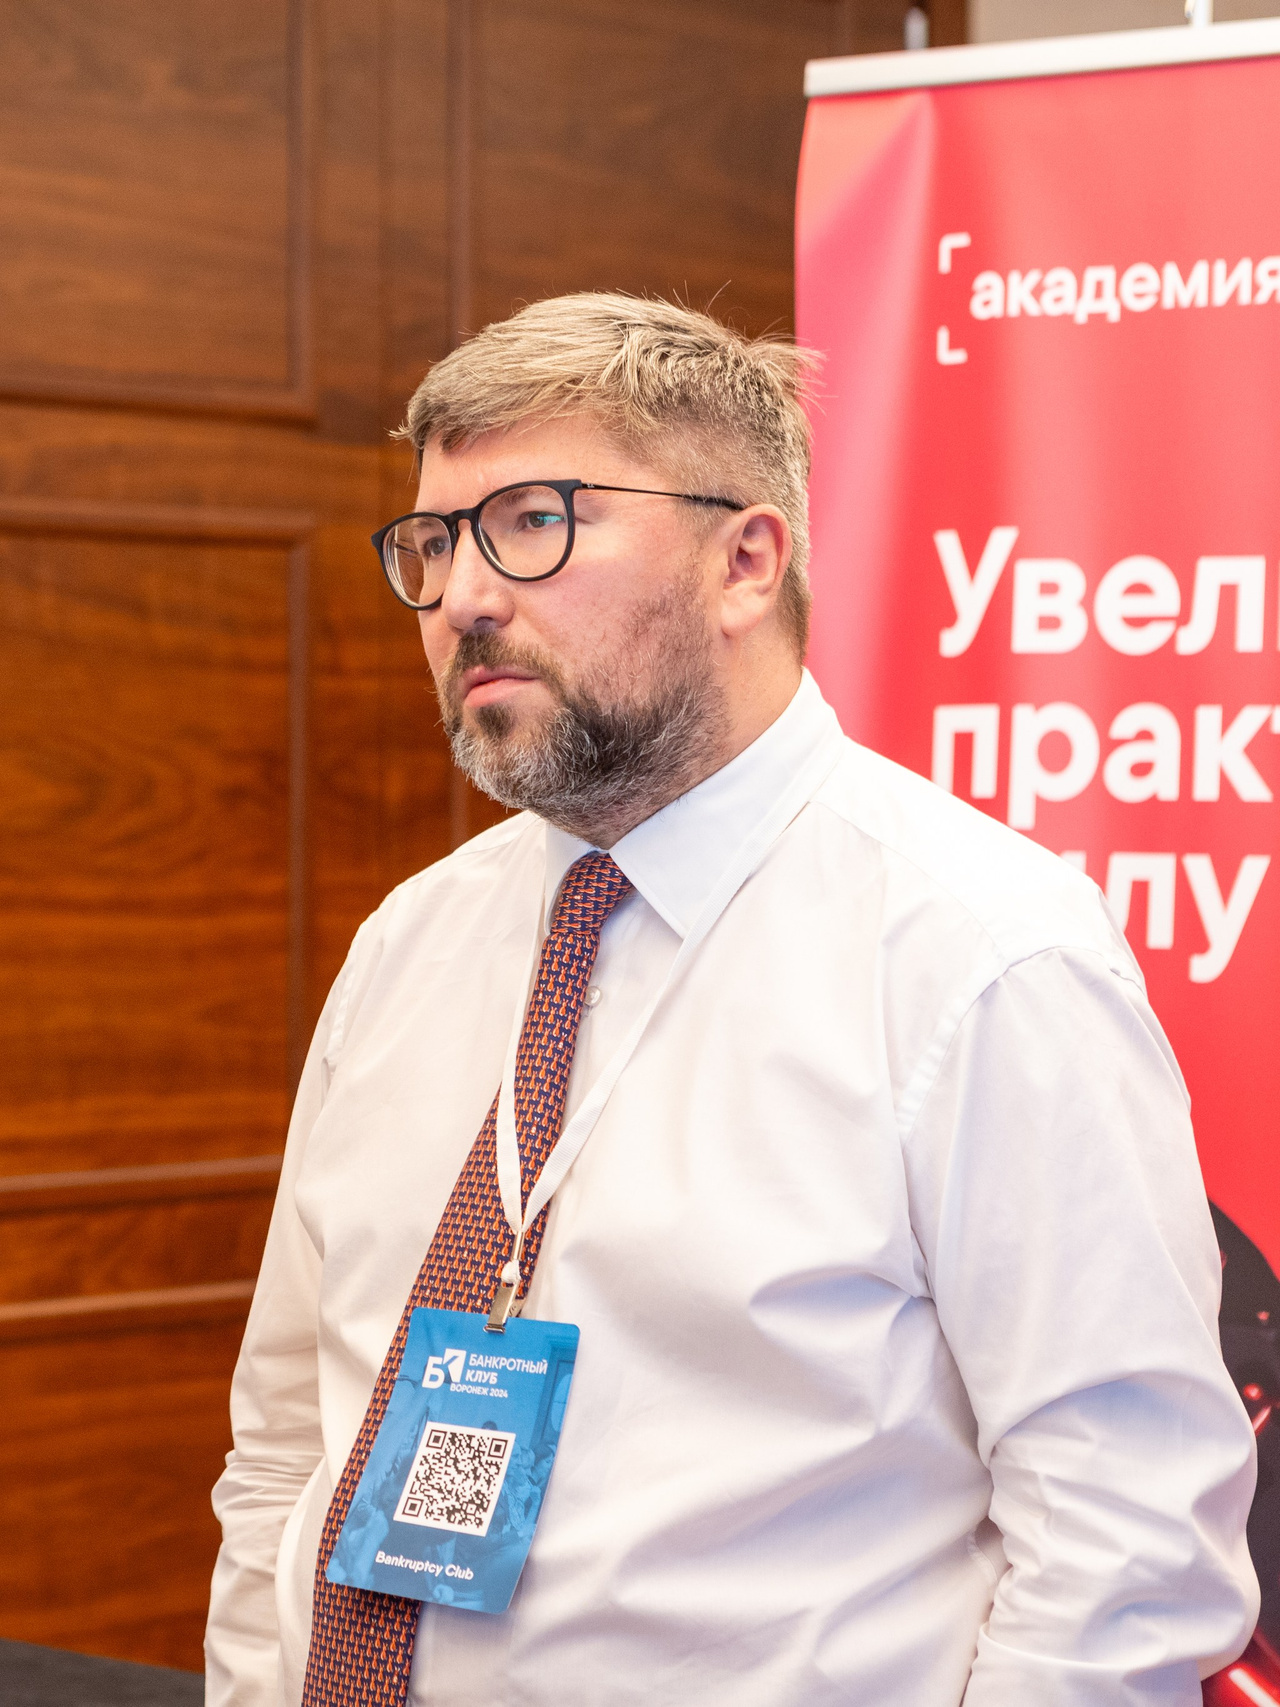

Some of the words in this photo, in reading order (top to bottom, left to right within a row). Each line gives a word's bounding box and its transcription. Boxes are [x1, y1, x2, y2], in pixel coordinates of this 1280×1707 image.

[969, 254, 1280, 326] академия
[933, 525, 1280, 658] Увел
[931, 701, 1280, 830] прак
[1059, 851, 1271, 984] лу
[465, 1369, 498, 1385] КЛУБ
[468, 1353, 548, 1375] БАНКРОТНЫЙ
[449, 1383, 489, 1396] ВОРОНЕЖ
[489, 1387, 508, 1398] 2024
[375, 1550, 444, 1577] Bankruptcy
[444, 1563, 474, 1580] Club
